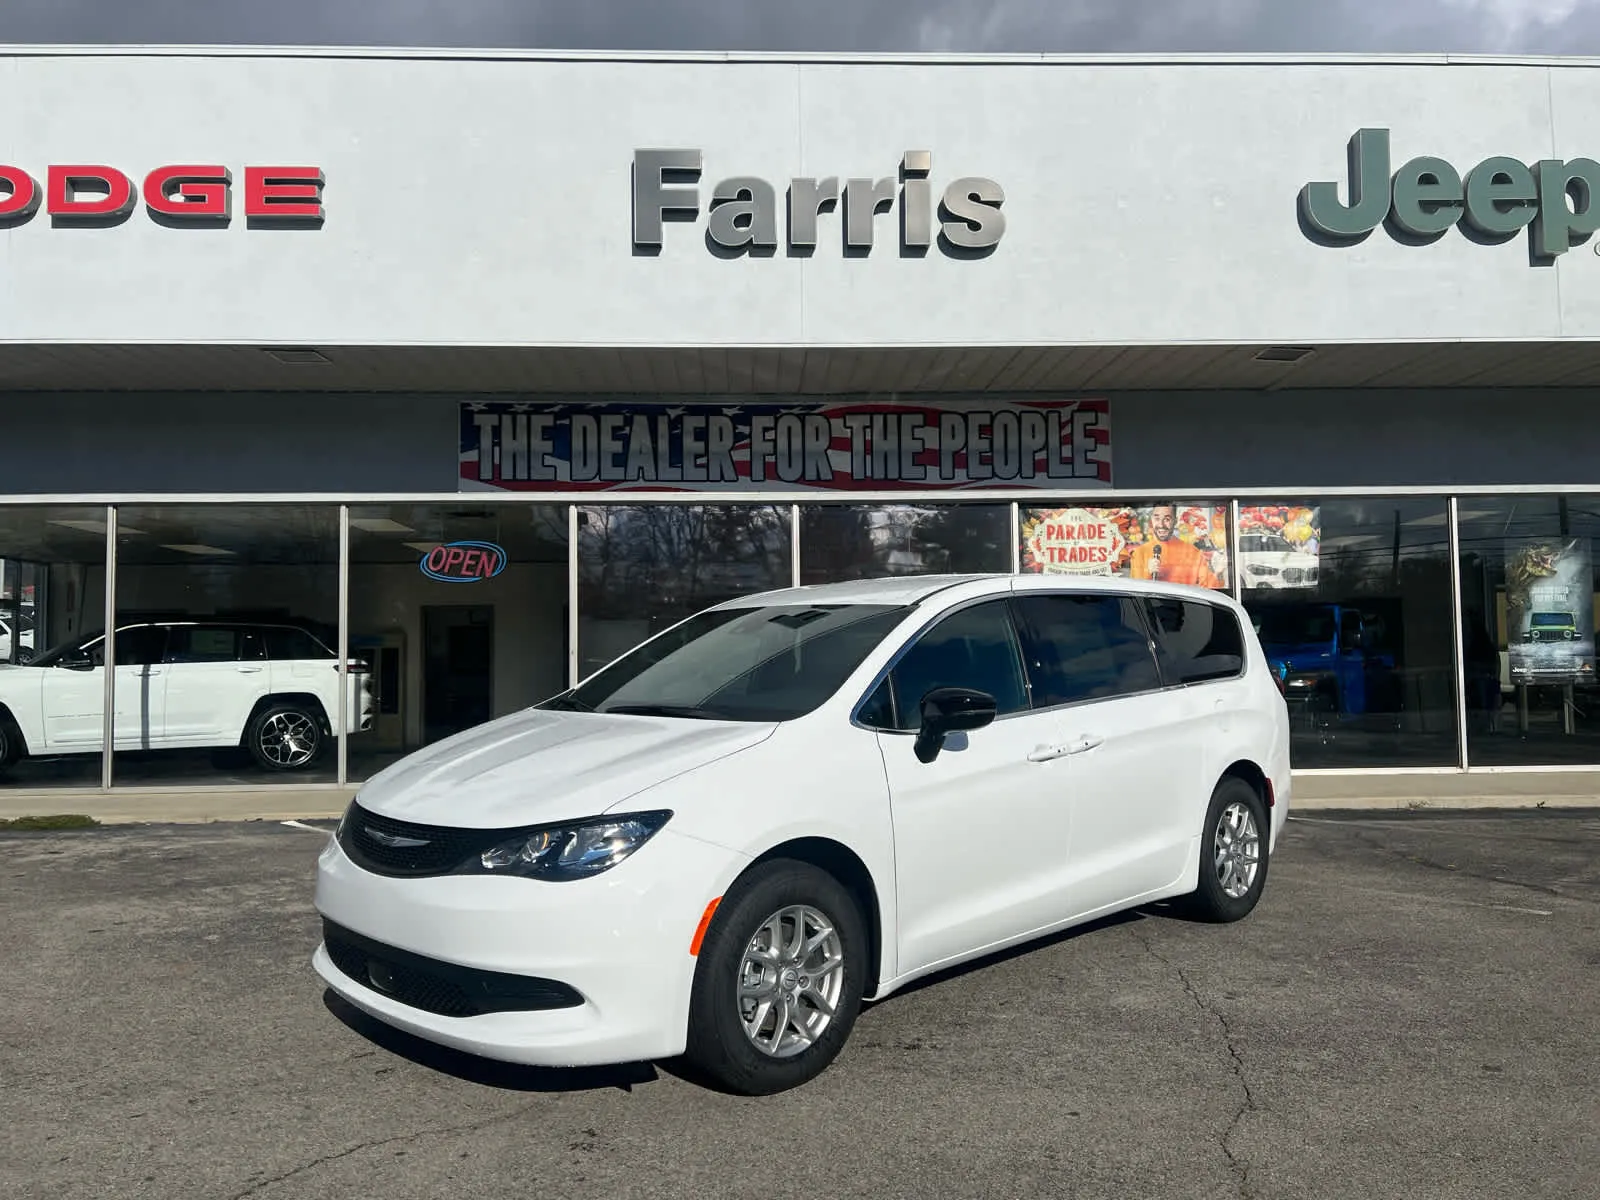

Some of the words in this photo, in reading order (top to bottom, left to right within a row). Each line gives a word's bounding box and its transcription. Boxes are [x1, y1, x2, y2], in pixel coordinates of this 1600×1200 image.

[632, 149, 1006, 258] Farris
[1297, 128, 1600, 266] Jeep
[473, 413, 557, 481] THE
[569, 413, 738, 482] DEALER
[750, 412, 833, 482] FOR
[844, 411, 927, 481] THE
[938, 410, 1098, 480] PEOPLE
[1046, 523, 1107, 541] PARADE
[1046, 546, 1107, 563] TRADES
[428, 545, 497, 578] OPEN
